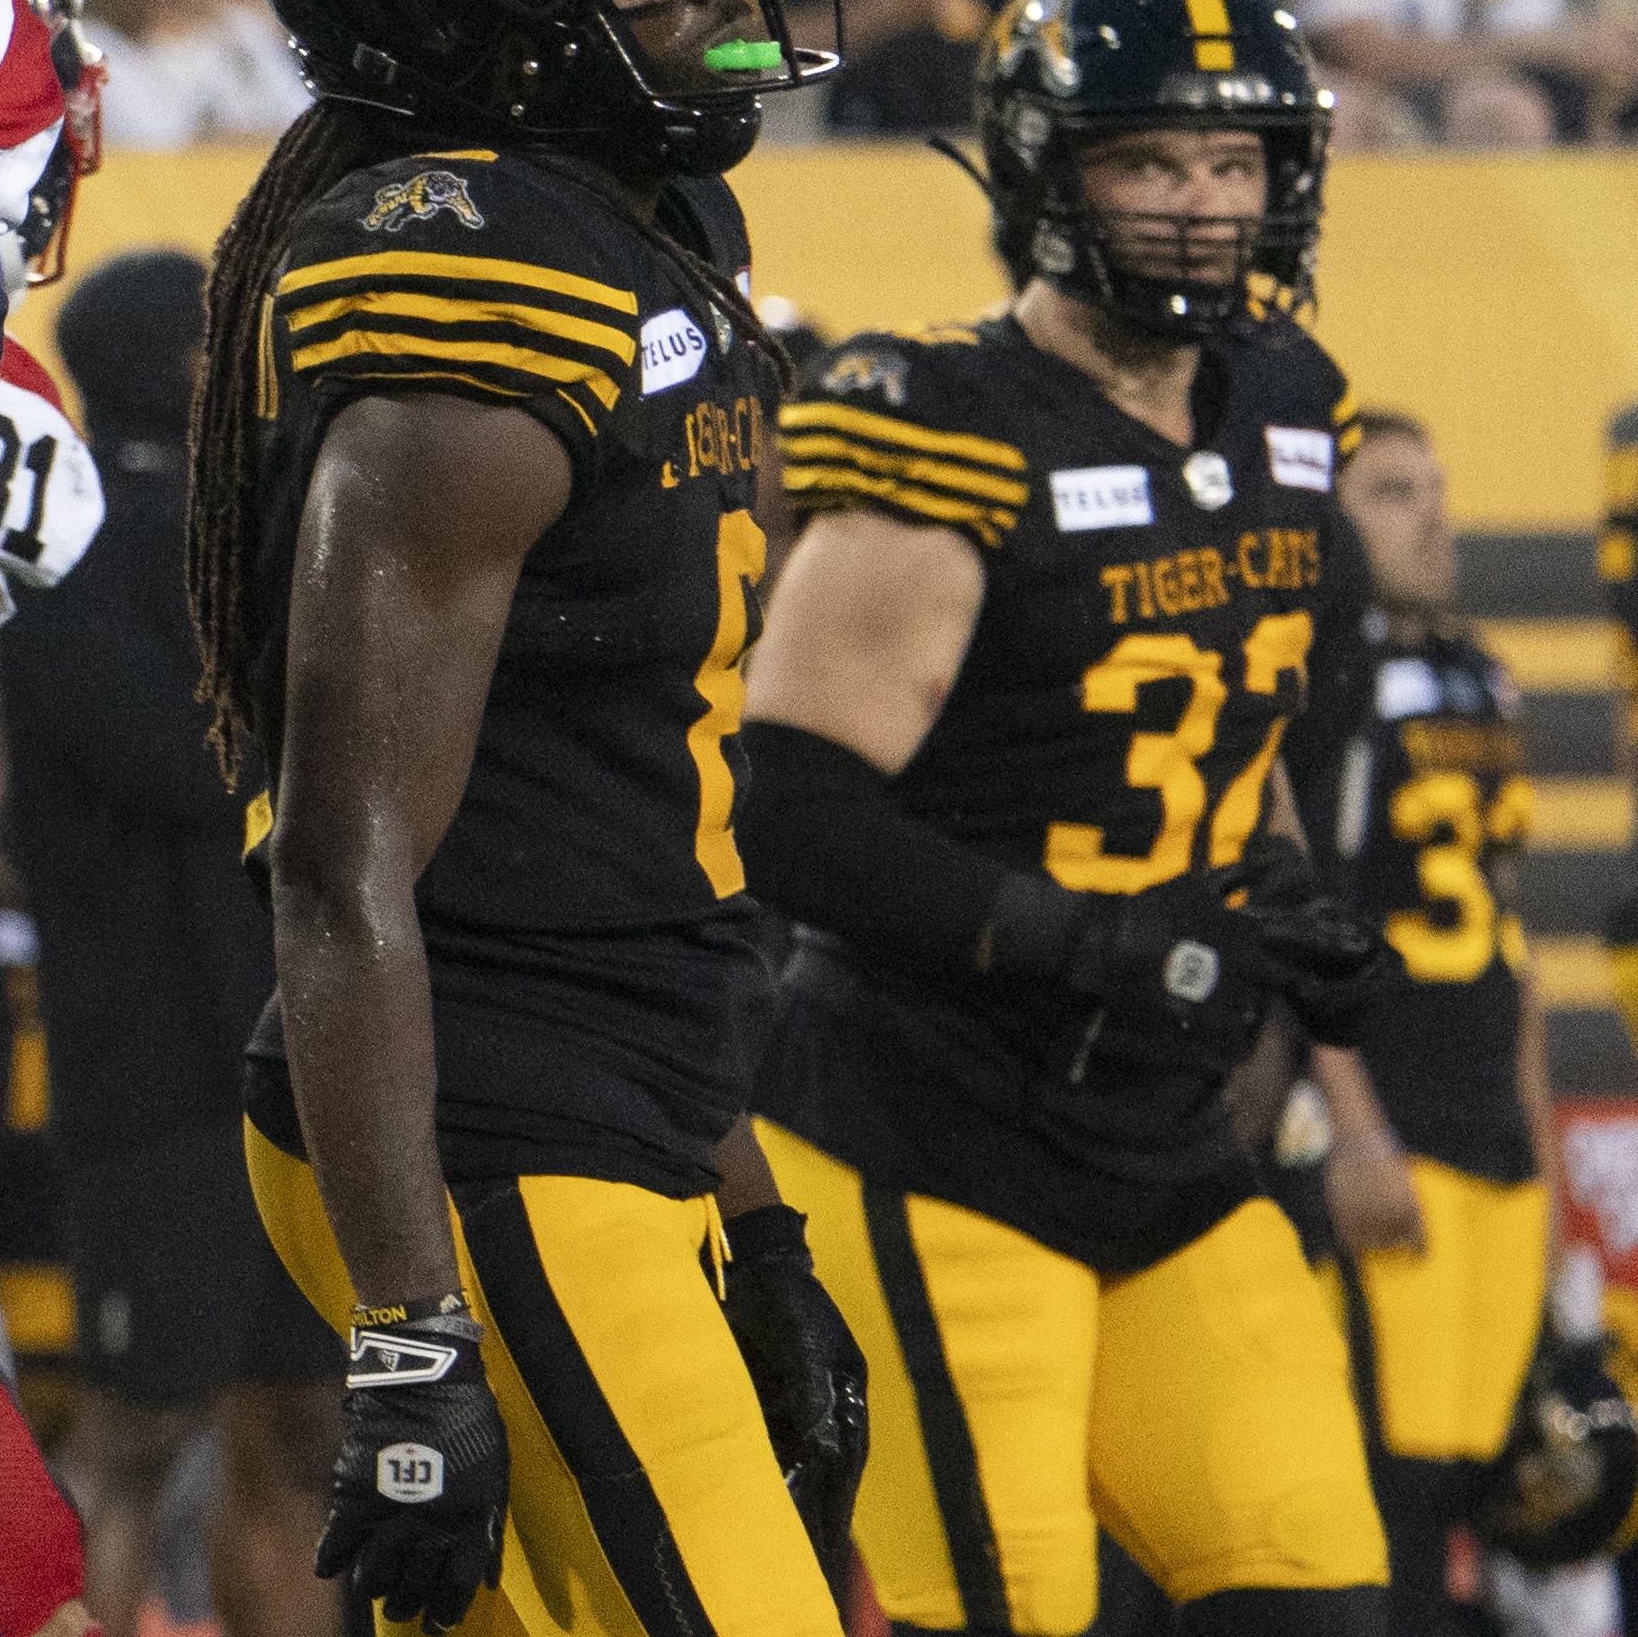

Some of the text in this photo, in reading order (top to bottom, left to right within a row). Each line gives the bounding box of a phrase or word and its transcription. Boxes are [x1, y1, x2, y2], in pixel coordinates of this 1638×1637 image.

[641, 325, 703, 372] TELUS
[1098, 528, 1322, 625] TIGER-CATS
[1043, 608, 1317, 907] 32
[387, 1459, 433, 1485] CFL
